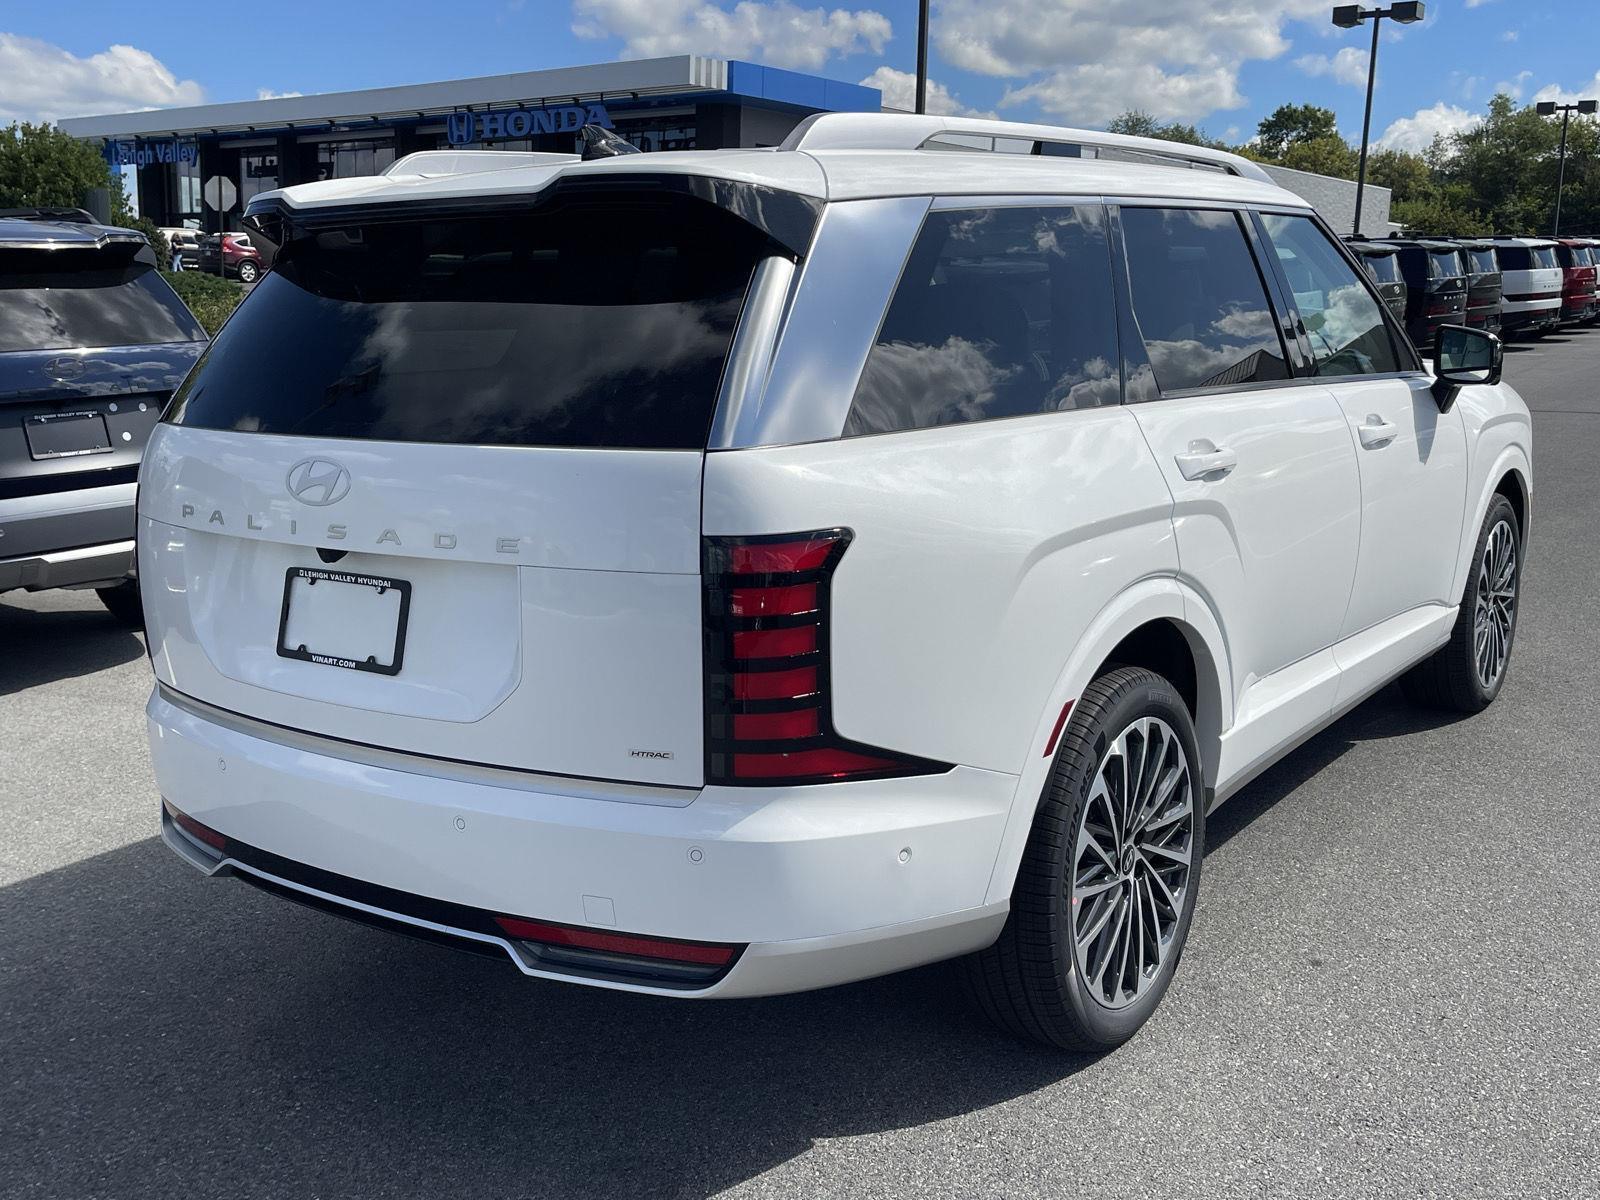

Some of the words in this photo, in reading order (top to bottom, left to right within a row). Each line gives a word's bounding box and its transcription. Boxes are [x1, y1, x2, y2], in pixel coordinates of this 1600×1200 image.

[481, 104, 615, 138] HONDA
[155, 141, 197, 167] Valley
[182, 504, 520, 554] PALISADE
[304, 570, 329, 580] LEHIGH
[330, 573, 356, 583] VALLEY
[357, 576, 391, 588] HYUNDAI
[311, 655, 356, 669] VINART.COM
[631, 750, 670, 759] HTRAC
